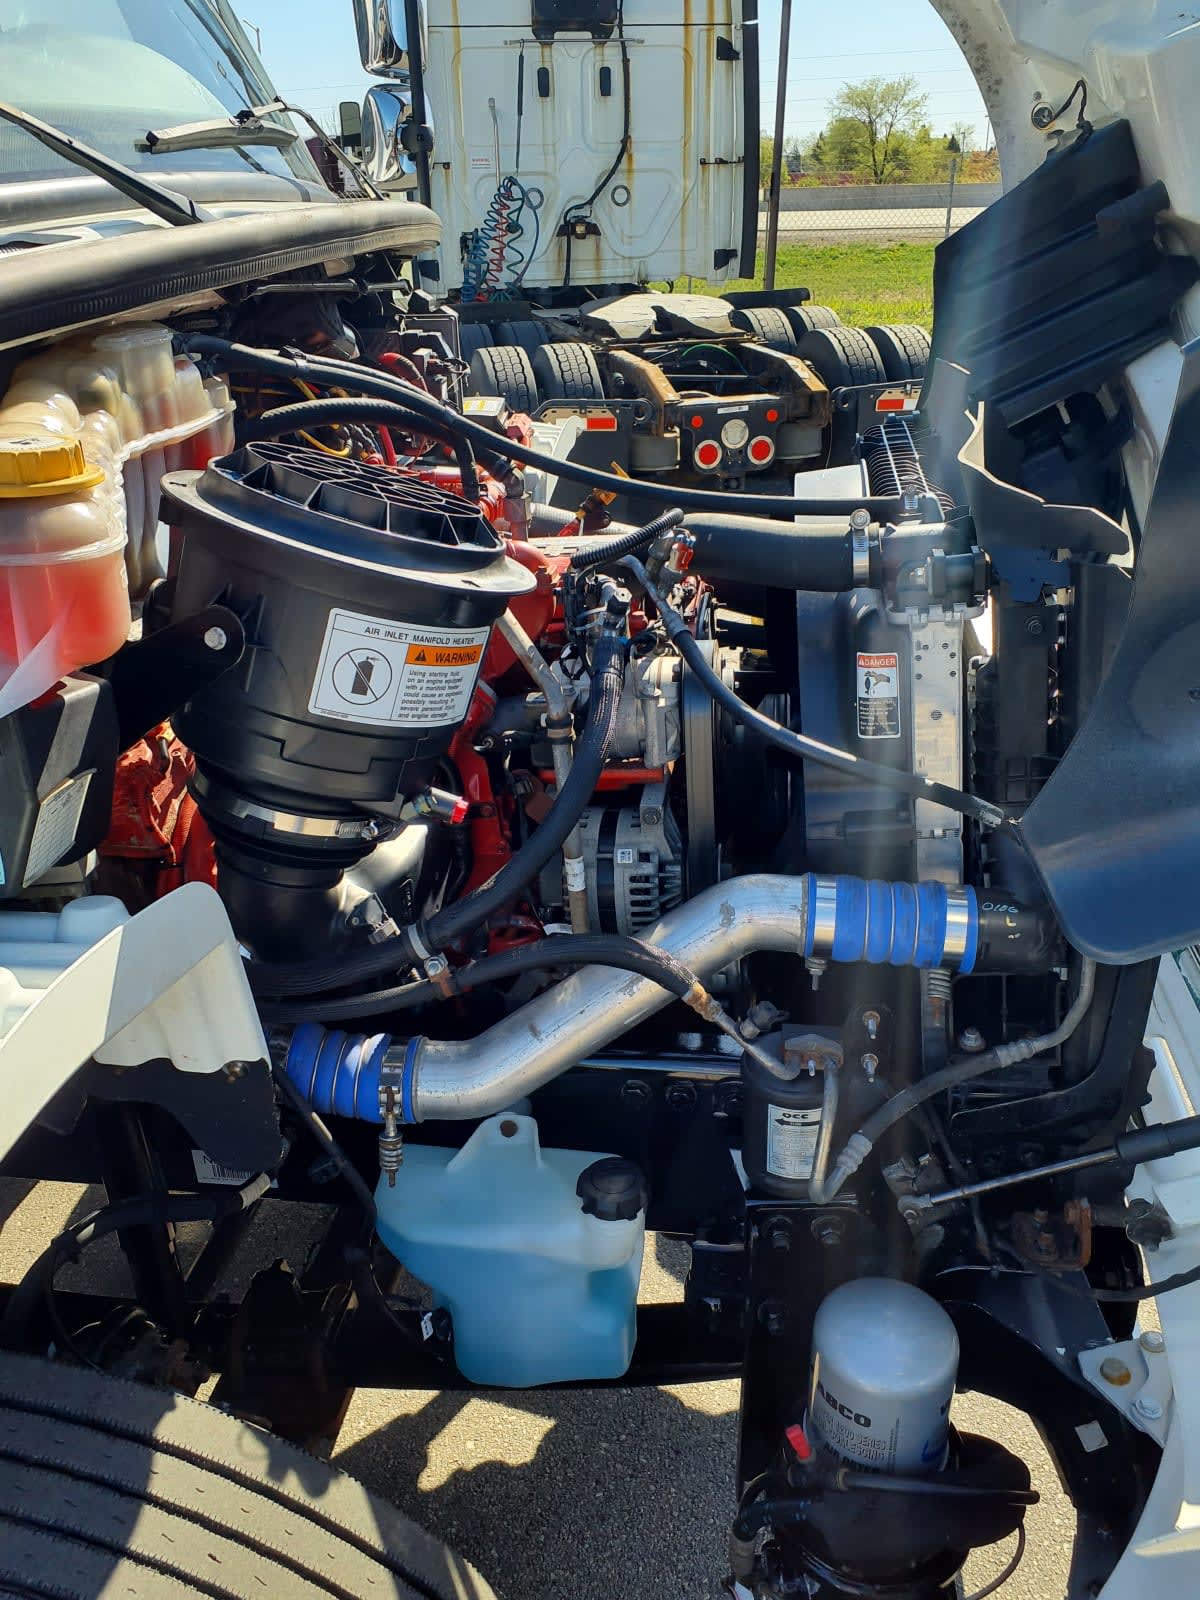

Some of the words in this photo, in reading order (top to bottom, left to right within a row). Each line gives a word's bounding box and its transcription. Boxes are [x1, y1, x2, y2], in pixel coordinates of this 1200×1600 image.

[364, 626, 380, 636] AIR
[384, 630, 409, 641] INLET
[412, 634, 450, 645] MANIFOLD
[452, 637, 475, 645] HEATER
[434, 650, 477, 664] WARNING
[864, 657, 896, 666] DANGER
[409, 670, 426, 678] Using
